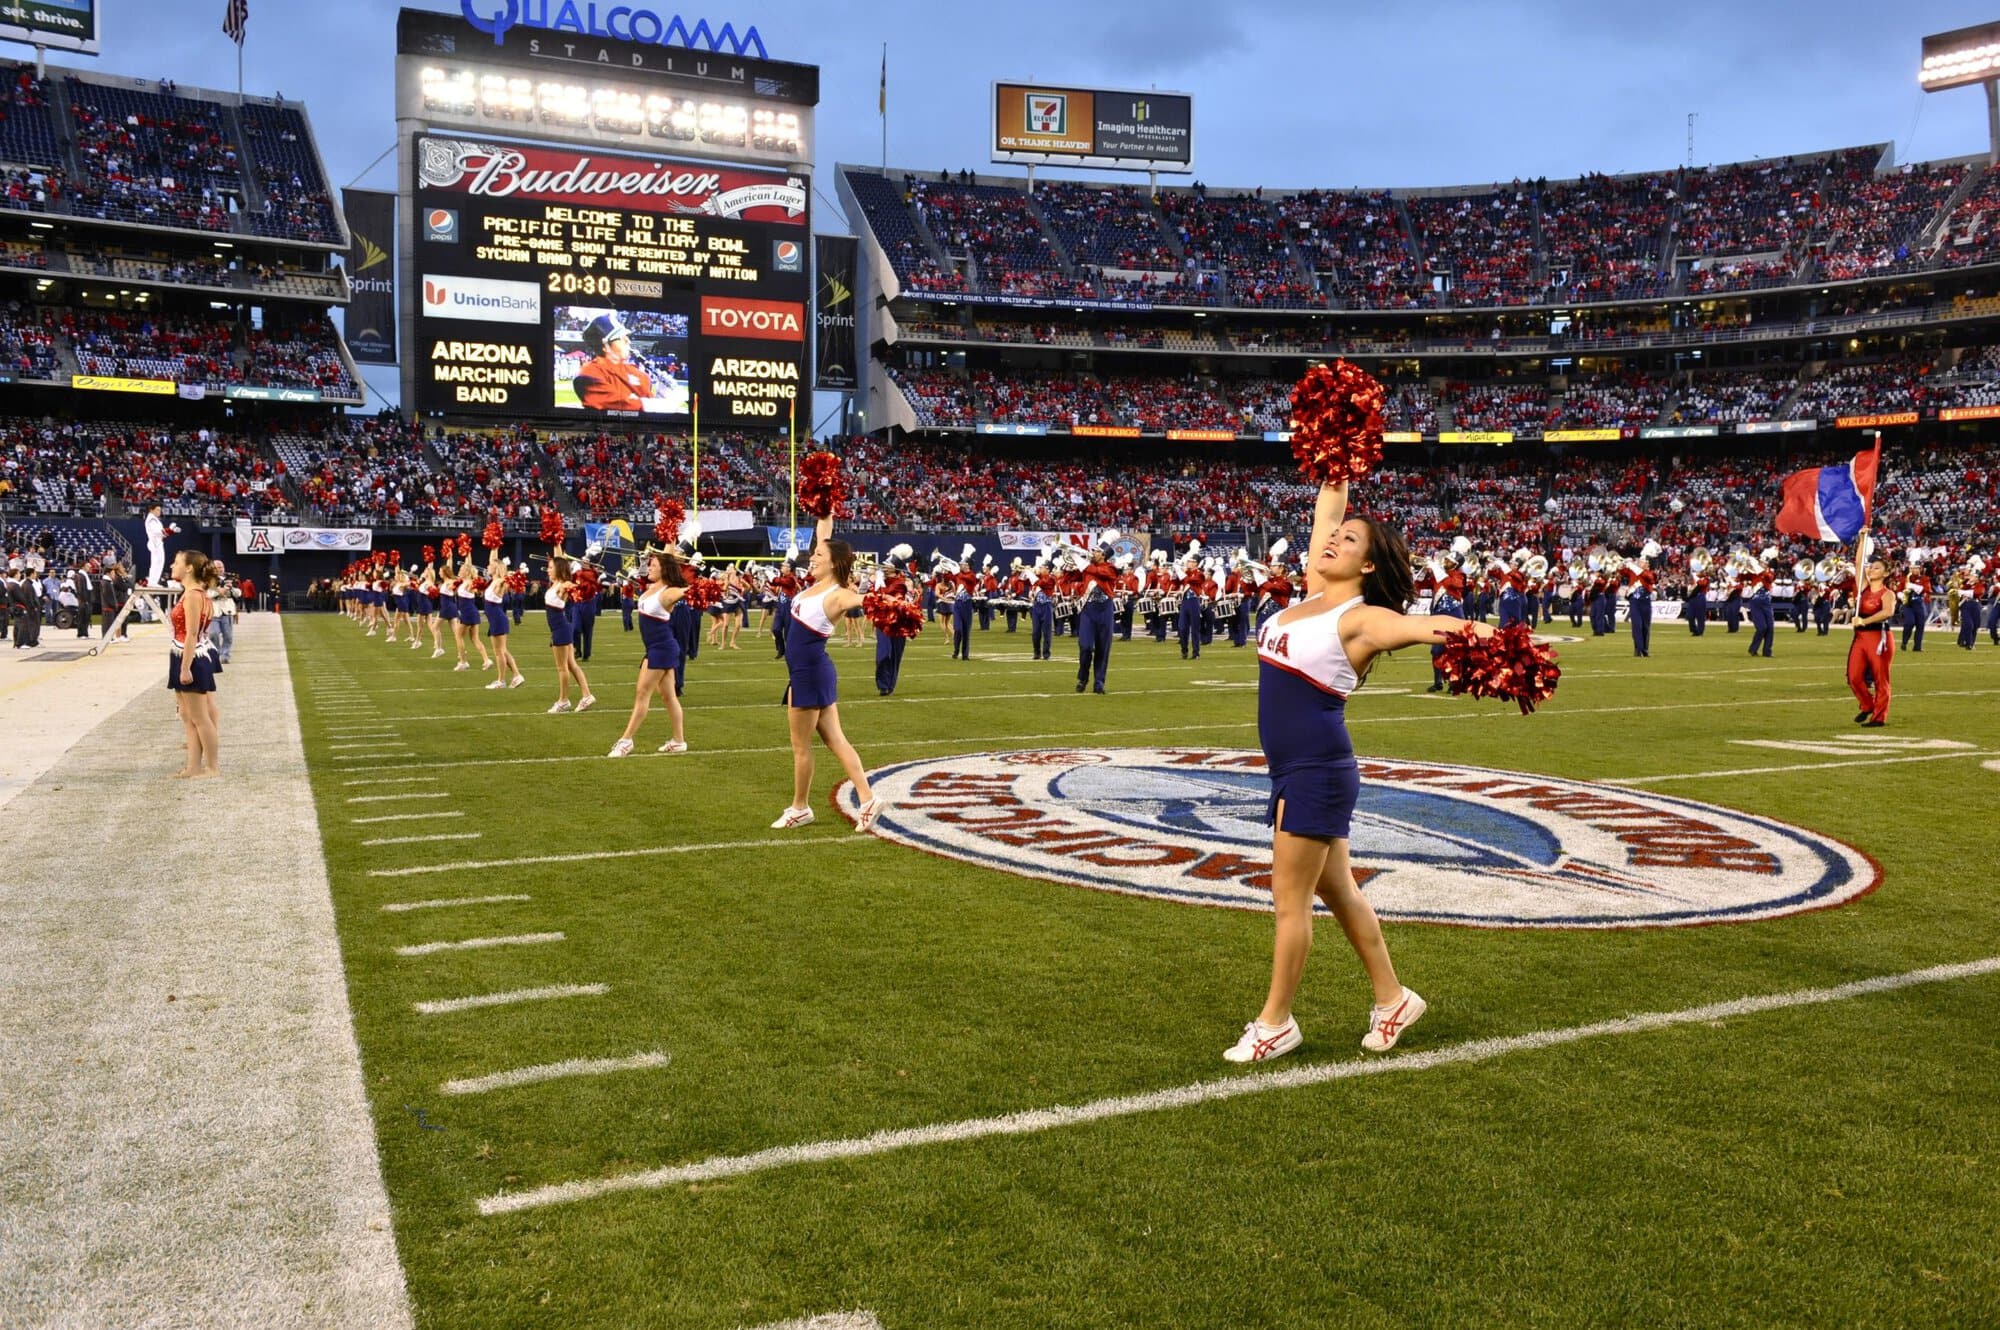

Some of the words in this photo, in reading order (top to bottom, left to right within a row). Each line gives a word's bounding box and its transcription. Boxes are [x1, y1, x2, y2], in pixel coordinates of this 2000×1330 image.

[33, 10, 84, 29] thrive.
[460, 0, 769, 59] QUALCOMM
[530, 40, 744, 80] STADIUM
[1097, 121, 1135, 134] Imaging
[1137, 123, 1186, 136] Healthcare
[1019, 138, 1051, 147] THANK
[1102, 141, 1118, 149] Your
[1120, 142, 1145, 150] Partner
[1156, 145, 1179, 153] Health
[460, 148, 718, 197] Budweiser
[723, 192, 770, 210] American
[773, 190, 803, 205] Lager
[545, 206, 622, 227] WELCOME
[632, 214, 654, 230] TO
[663, 217, 695, 233] THE
[484, 216, 563, 236] PACIFIC
[572, 224, 616, 241] LIFE
[625, 229, 700, 249] HOLIDAY
[708, 236, 749, 253] BOWL
[494, 234, 564, 251] PRE-GAME
[571, 240, 606, 255] SHOW
[613, 244, 687, 261] PRESENTED
[693, 251, 710, 264] BY
[717, 253, 742, 267] THE
[476, 246, 530, 263] SYCUAN
[537, 250, 573, 266] BAND
[579, 254, 597, 268] OF
[605, 256, 630, 271] THE
[709, 265, 758, 281] NATION
[347, 275, 392, 294] Sprint
[548, 272, 611, 296] 20:30
[454, 291, 537, 310] UnionBank
[706, 308, 799, 331] TOYOTA
[816, 312, 855, 329] Sprint
[431, 341, 533, 365] ARIZONA
[434, 364, 530, 385] MARCHING
[710, 358, 799, 379] ARIZONA
[456, 386, 508, 403] BAND
[712, 380, 797, 399] MARCHING
[732, 400, 778, 416] BAND
[1837, 416, 1877, 426] WELLS
[1878, 413, 1918, 424] FARGO
[1073, 426, 1106, 435] WELLS
[1107, 427, 1140, 436] FARGO
